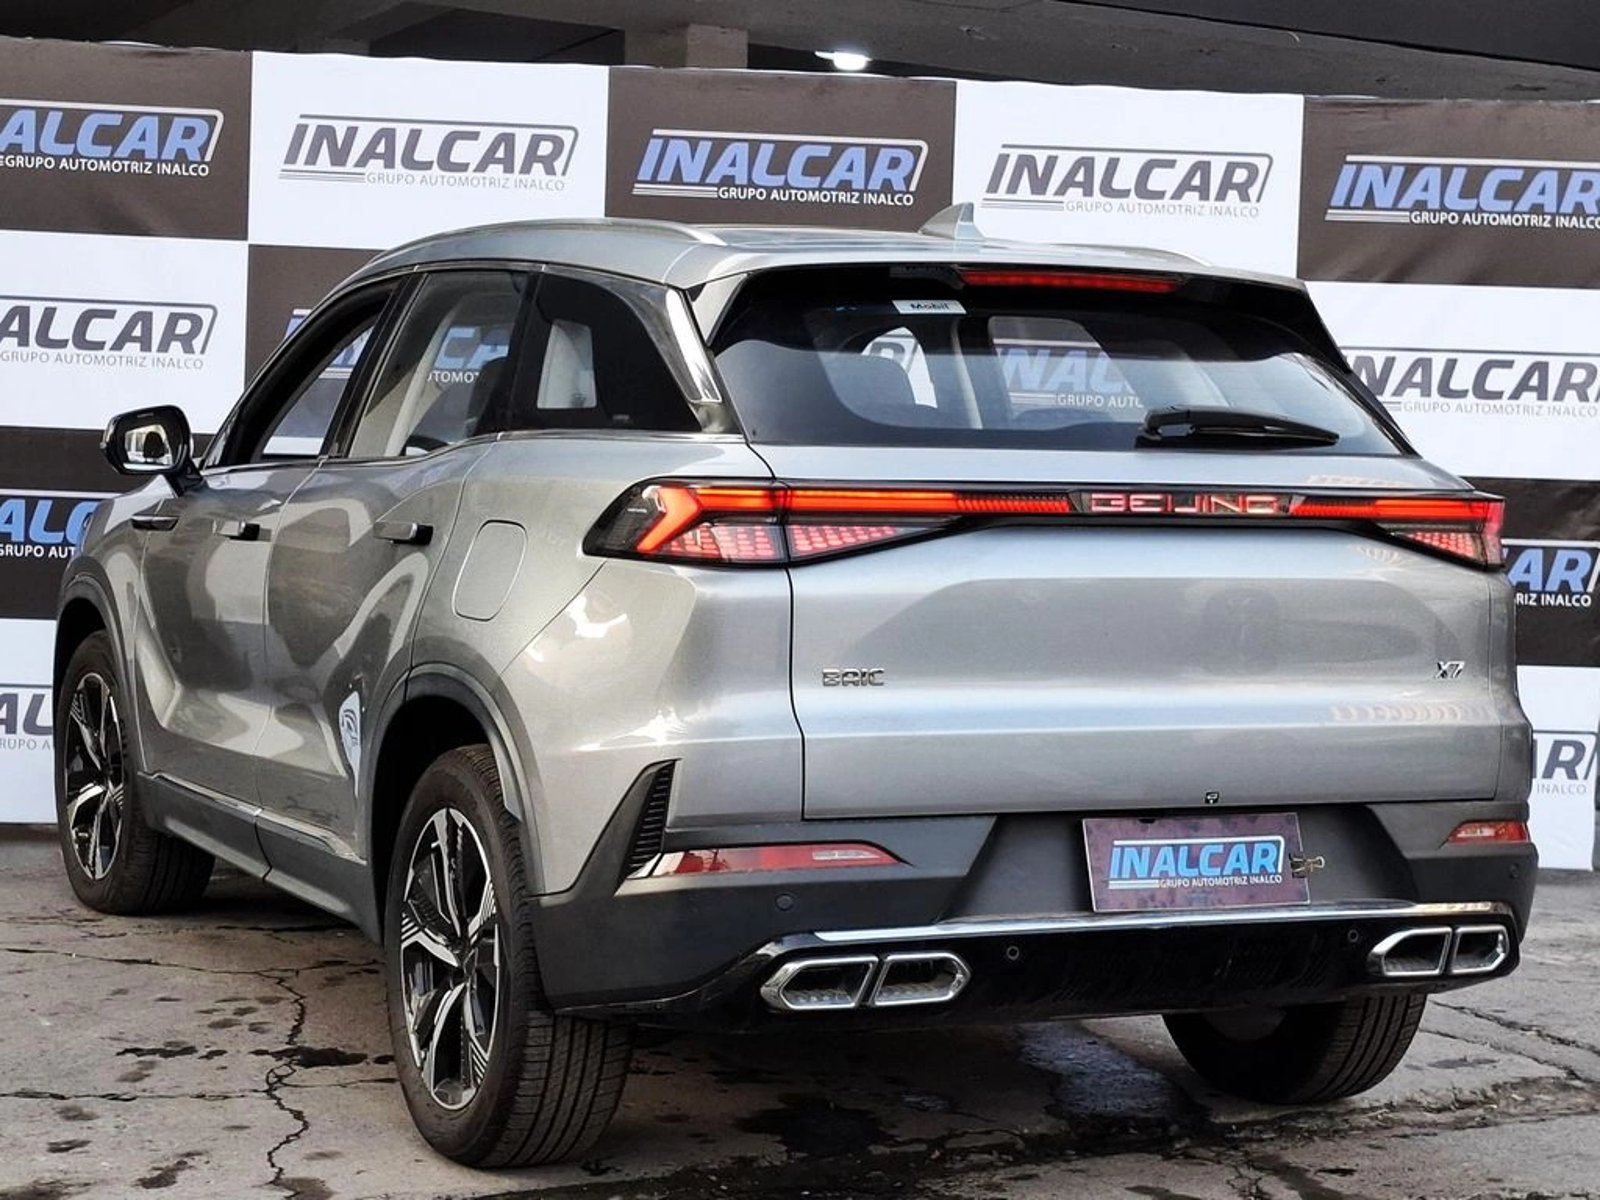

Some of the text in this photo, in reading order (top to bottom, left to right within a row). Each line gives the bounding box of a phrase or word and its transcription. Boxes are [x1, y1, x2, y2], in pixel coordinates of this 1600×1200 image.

[284, 124, 565, 176] INALCAR
[5, 155, 209, 177] GRUPO AUTOMOTRIZ INALCO
[637, 138, 915, 191] INALCAR
[366, 173, 565, 191] GRUPO AUTOMOTRIZ INALCO
[986, 153, 1259, 203] INALCAR
[718, 187, 914, 206] GRUPO AUTOMOTRIZ INALCO
[1331, 164, 1600, 214] INALCAR
[1066, 201, 1259, 218] GRUPO AUTOMOTRIZ INALCO
[1411, 211, 1458, 225] GRUPO
[1462, 213, 1551, 228] AUTOMOTRIZ
[0, 351, 204, 369] GRUPO AUTOMOTRIZ INALCO
[1343, 355, 1598, 403] NALCAR
[1058, 394, 1104, 407] GRUPO
[1403, 401, 1598, 418] GRUPO AUTOMOTRIZ INALCO
[1541, 594, 1592, 607] INALCO
[1434, 661, 1465, 679] X7
[1536, 783, 1588, 796] INALCO
[1109, 842, 1278, 879] INALCAR
[1159, 873, 1283, 889] GRUPO AUTOMOTRIZ INALCO
